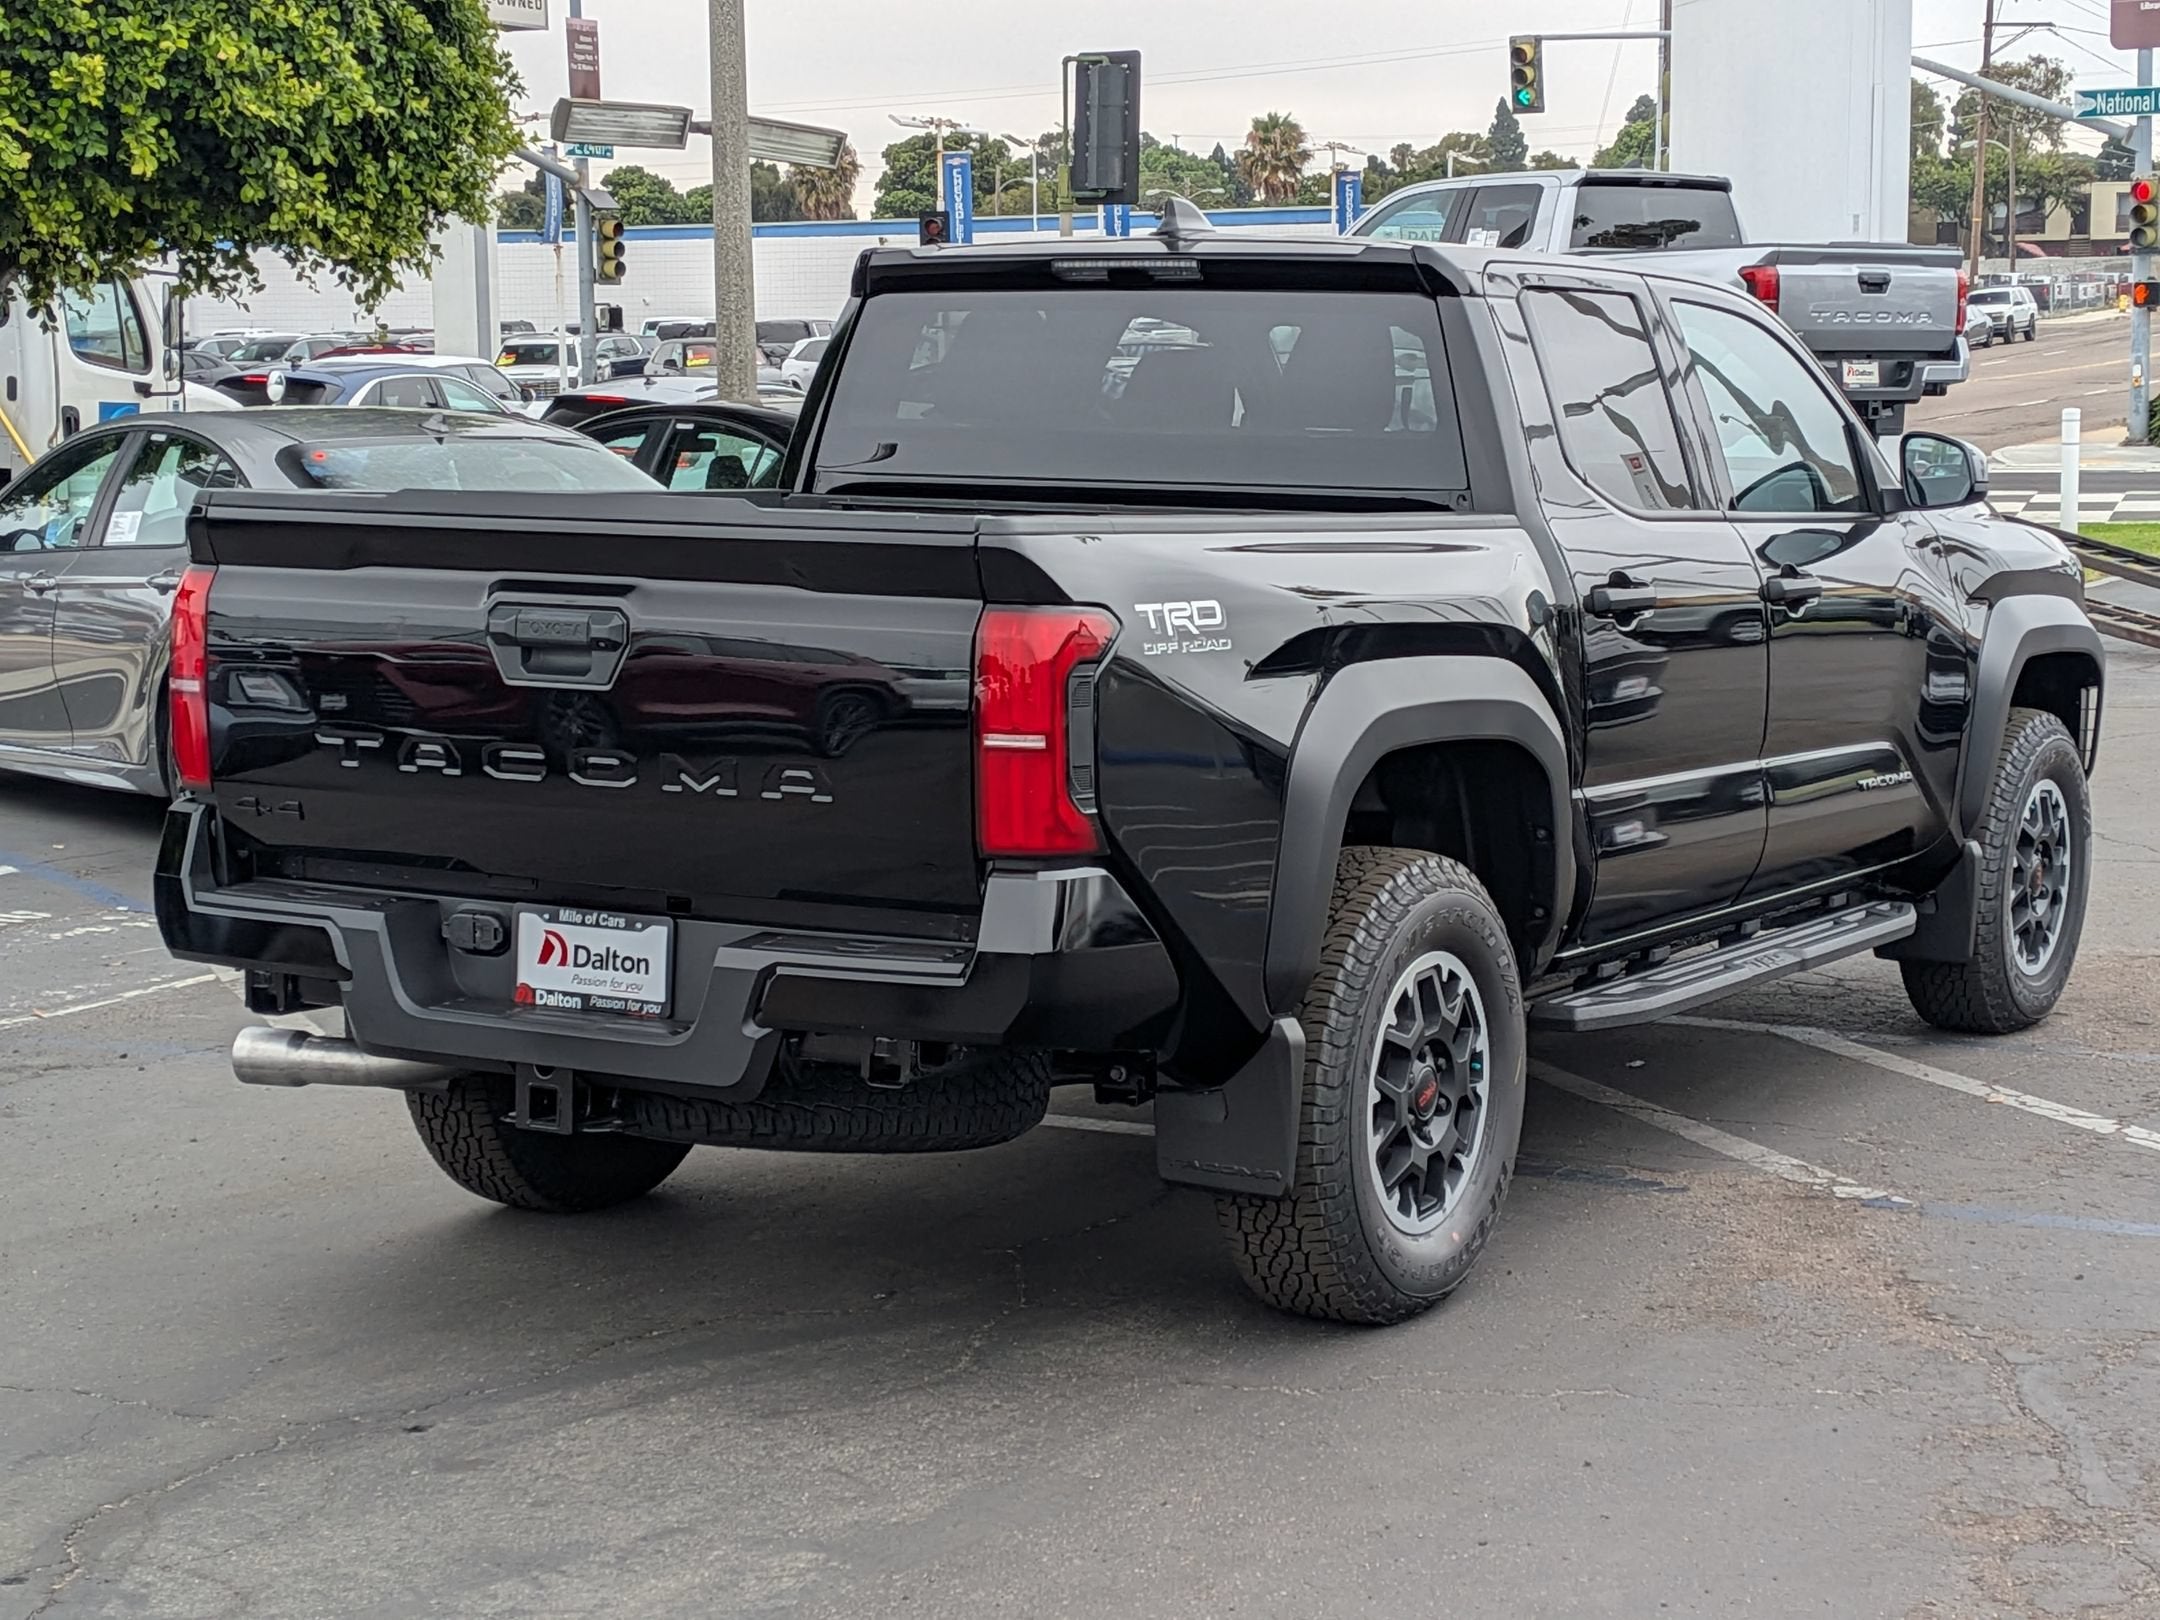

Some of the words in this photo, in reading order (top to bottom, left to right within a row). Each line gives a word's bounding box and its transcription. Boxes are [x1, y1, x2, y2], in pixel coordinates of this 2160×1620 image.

[2096, 91, 2155, 114] National
[1811, 310, 1933, 323] TACOMA
[1134, 600, 1223, 636] TRD
[520, 620, 582, 637] TOYOTA
[1143, 641, 1179, 655] OFF
[1182, 638, 1232, 654] ROAD
[314, 729, 833, 803] TACOMA
[1856, 771, 1913, 791] TACOMA
[559, 909, 583, 923] Mile
[584, 914, 598, 925] of
[599, 915, 626, 928] Cars
[573, 944, 649, 975] Dalton
[571, 974, 611, 987] Passion
[609, 979, 624, 990] for
[625, 983, 644, 992] you
[535, 989, 582, 1009] Dalton
[590, 995, 626, 1009] Passion
[627, 999, 642, 1012] for
[643, 1003, 662, 1014] you
